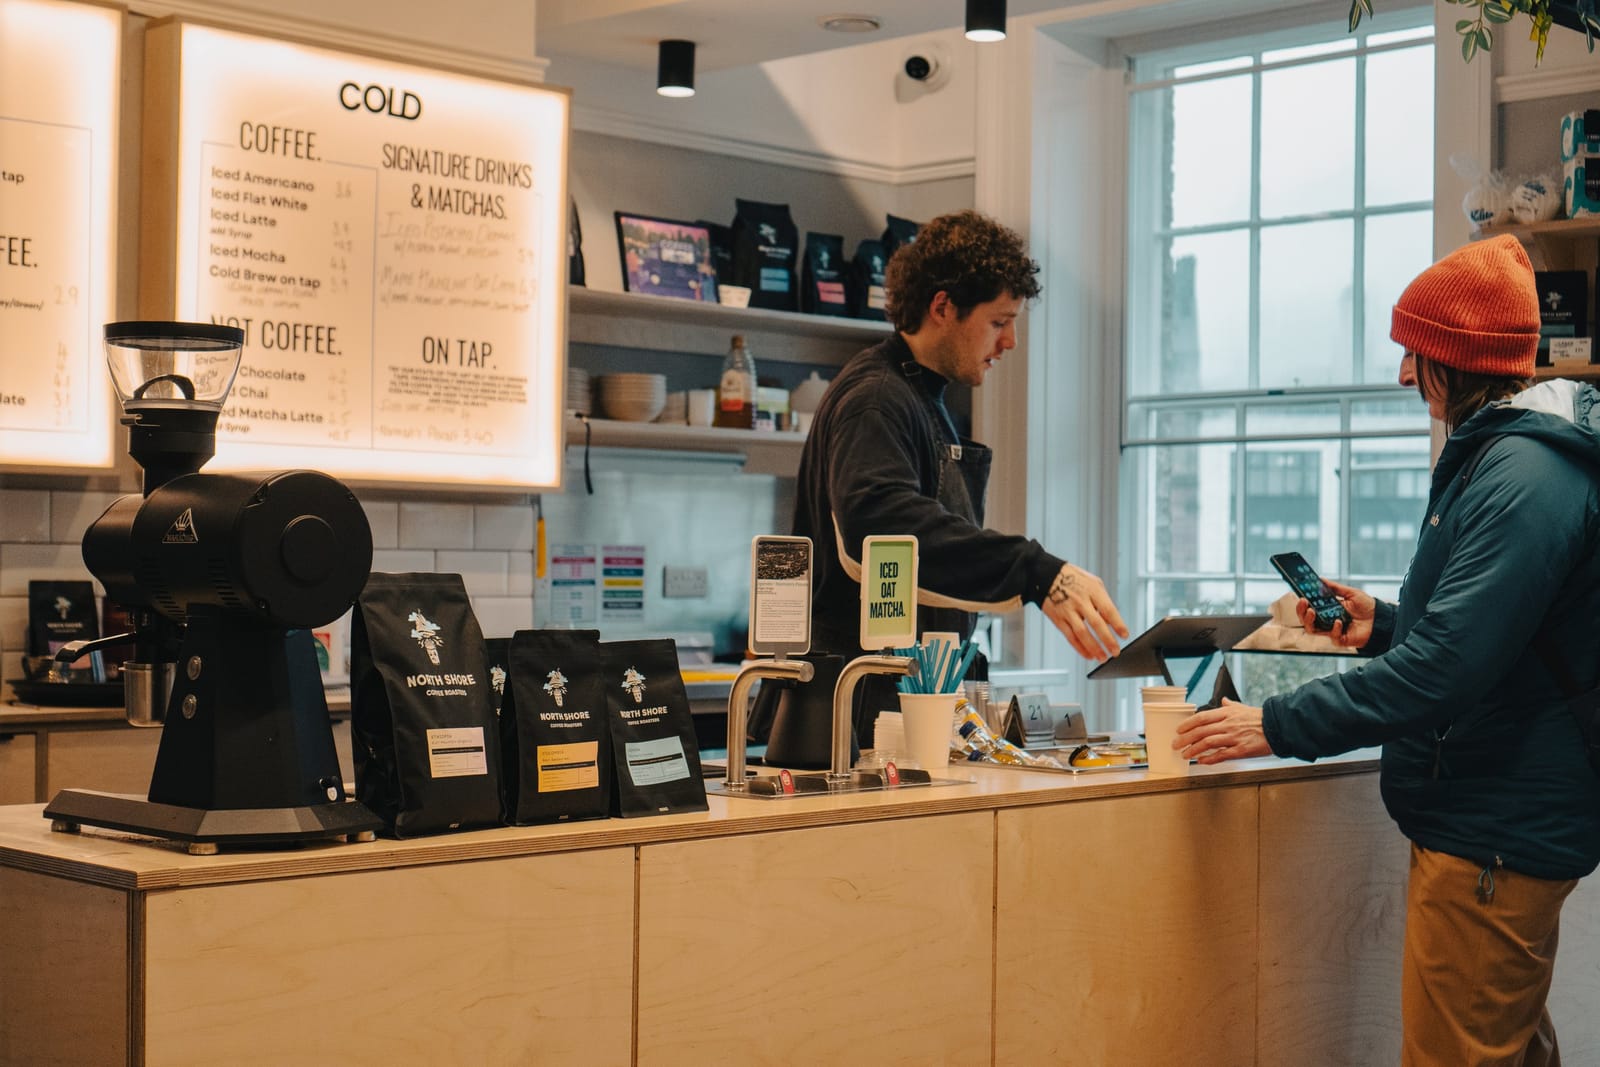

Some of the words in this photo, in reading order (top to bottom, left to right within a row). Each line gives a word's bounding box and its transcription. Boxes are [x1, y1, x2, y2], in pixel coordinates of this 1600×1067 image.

[338, 82, 422, 120] COLD
[239, 121, 322, 161] COFFEE.
[382, 143, 472, 182] SIGNATURE
[475, 157, 533, 190] DRINKS
[2, 171, 25, 187] tap
[211, 165, 240, 182] Iced
[243, 171, 316, 193] Americano
[211, 187, 240, 203] Iced
[242, 192, 267, 207] Flat
[269, 195, 309, 213] White
[410, 182, 424, 210] &
[427, 184, 508, 221] MATCHAS.
[210, 207, 240, 223] Iced
[242, 212, 278, 228] Latte
[209, 243, 239, 259] Iced
[241, 247, 287, 265] Mocha
[208, 264, 240, 280] Cold
[242, 269, 278, 284] Brew
[279, 274, 297, 286] on
[298, 275, 322, 290] tap
[260, 319, 344, 357] COFFEE.
[421, 336, 450, 366] ON
[456, 338, 498, 371] TAP.
[239, 364, 307, 383] Chocolate
[239, 384, 269, 401] Chai
[239, 407, 288, 422] Matcha
[289, 409, 325, 425] Latte
[879, 561, 899, 579] ICED
[880, 581, 897, 599] OAT
[869, 600, 906, 620] MATCHA.
[406, 673, 445, 689] NORTH
[443, 672, 478, 687] SHORE
[539, 711, 565, 721] NORTH
[563, 709, 592, 720] SHORE
[641, 704, 669, 718] SHORE
[1028, 704, 1044, 721] 21
[1064, 712, 1073, 729] 1
